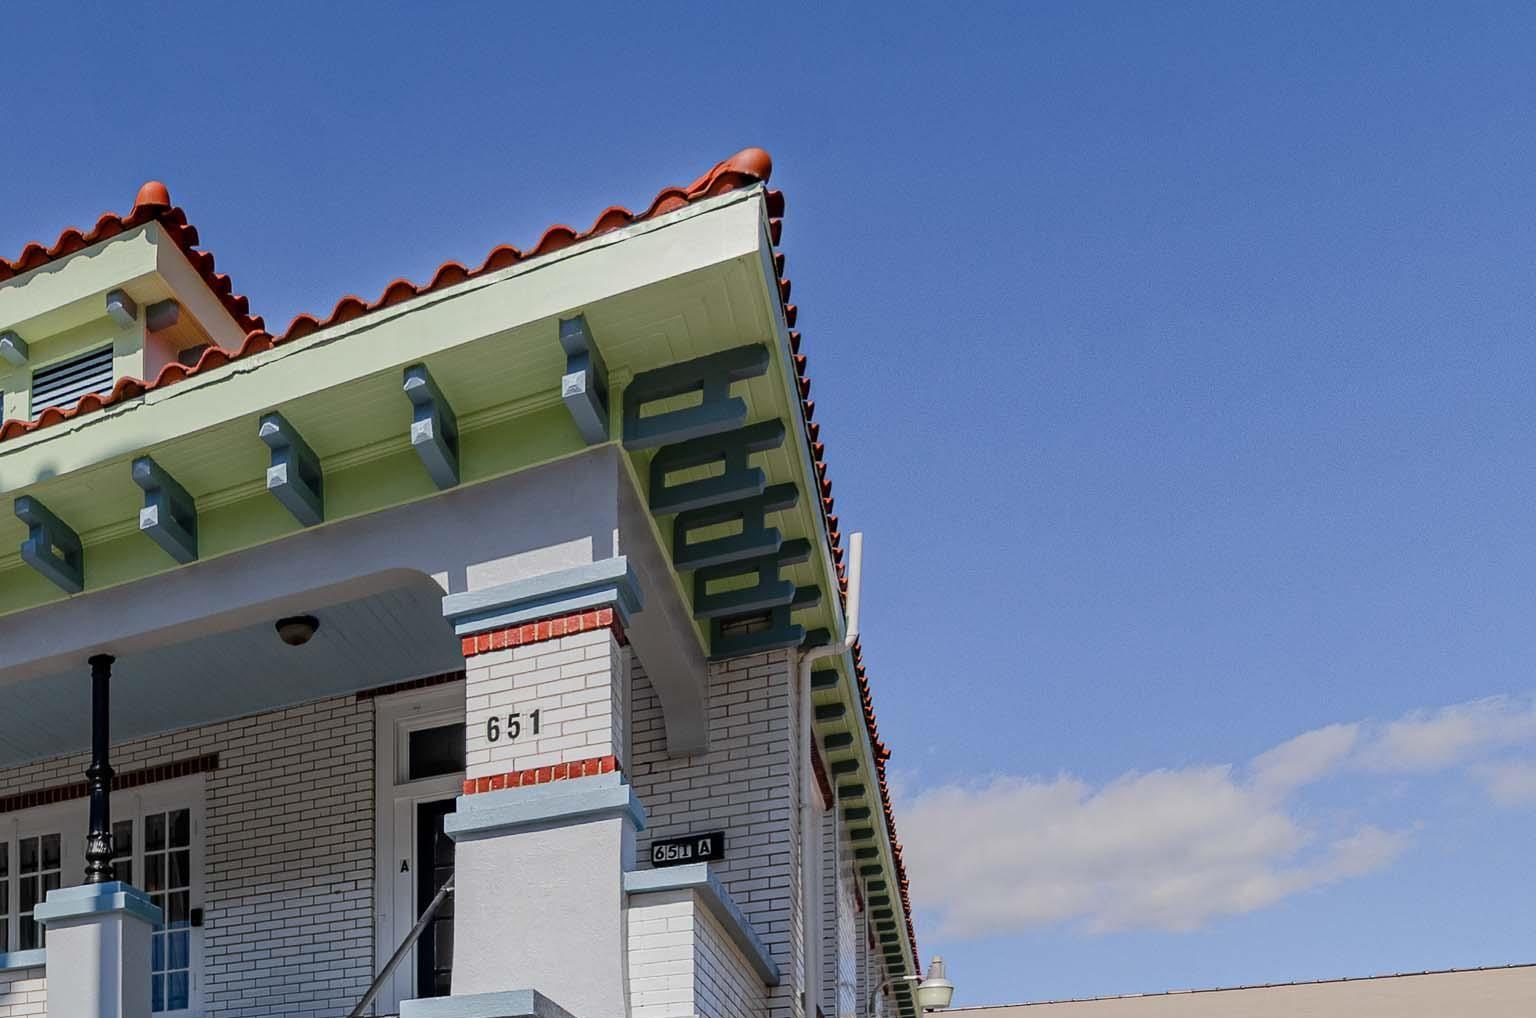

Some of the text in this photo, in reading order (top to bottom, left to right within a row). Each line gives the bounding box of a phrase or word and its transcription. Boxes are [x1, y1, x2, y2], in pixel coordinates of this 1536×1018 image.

[487, 709, 540, 742] 651
[655, 840, 711, 860] 651 A
[400, 859, 410, 873] A
